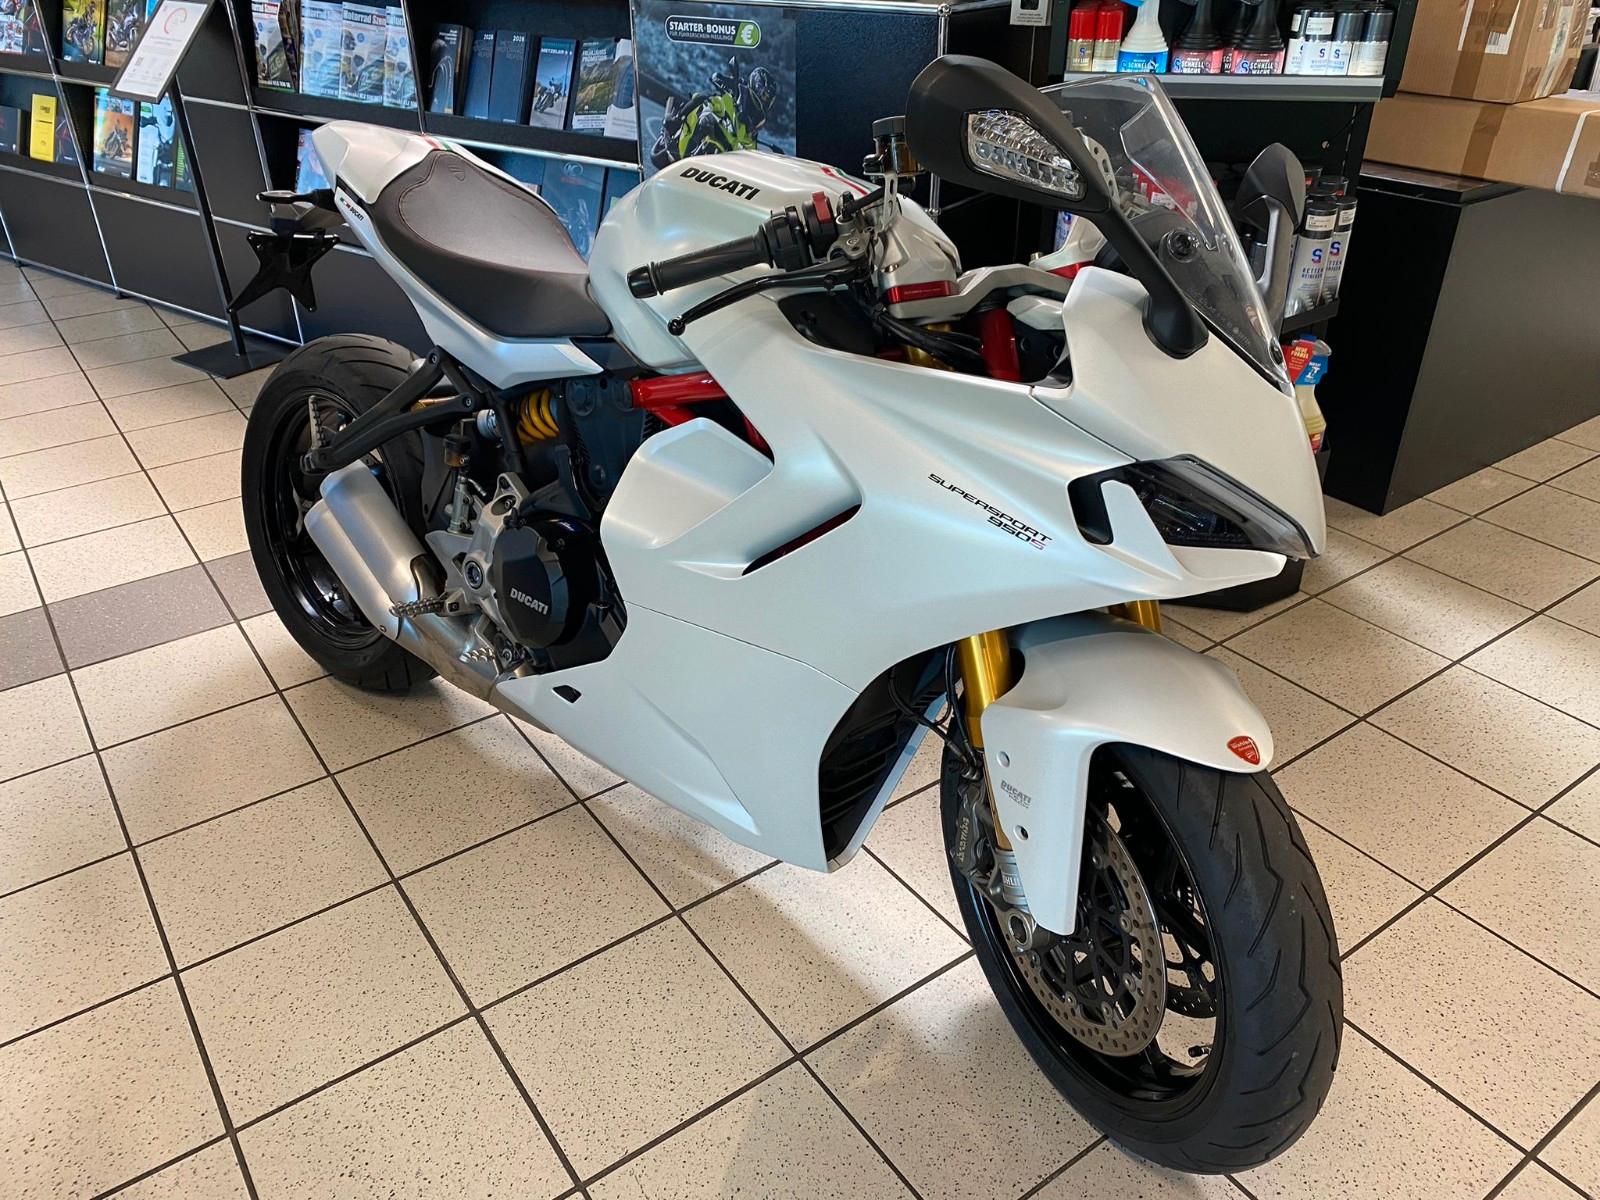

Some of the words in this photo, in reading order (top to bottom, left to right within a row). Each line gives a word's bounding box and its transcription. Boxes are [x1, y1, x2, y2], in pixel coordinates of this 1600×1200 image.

[343, 9, 371, 24] Motorrad
[372, 14, 386, 27] Szen
[680, 167, 760, 200] DUCATI
[928, 473, 1053, 542] SUPERSPORT
[510, 587, 549, 615] DUCATI
[1001, 780, 1032, 803] DUCATI
